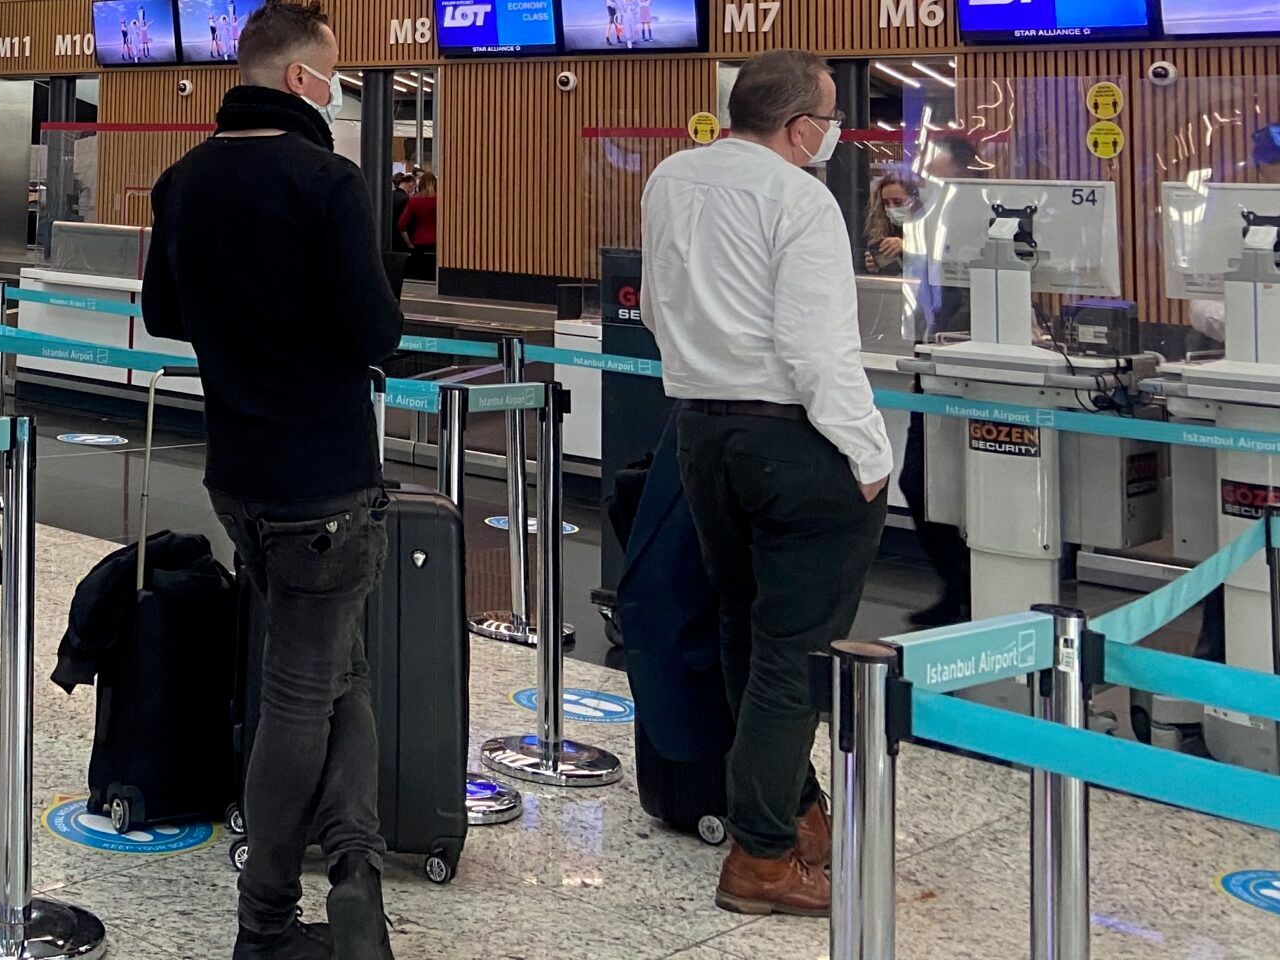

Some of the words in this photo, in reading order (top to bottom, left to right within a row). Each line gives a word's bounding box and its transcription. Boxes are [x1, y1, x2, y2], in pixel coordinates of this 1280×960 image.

[507, 1, 548, 11] ECONOMY
[443, 4, 492, 28] LOT
[522, 12, 549, 22] CLASS
[723, 1, 781, 34] M7
[389, 17, 432, 45] M8
[1014, 29, 1036, 37] STAR
[1037, 27, 1081, 36] ALLIANCE
[54, 33, 95, 57] M10
[1071, 188, 1098, 207] 54
[42, 347, 69, 359] Istanbul
[70, 349, 94, 362] Airport
[573, 355, 606, 369] Istanbul
[606, 359, 635, 372] Airport
[396, 394, 428, 409] Airport
[945, 404, 990, 419] Istanbul
[992, 408, 1031, 423] Airport
[969, 421, 1039, 445] GÖZEN
[1183, 431, 1234, 447] Istanbul
[1238, 437, 1280, 453] Airport
[971, 439, 1038, 455] SECURITY
[926, 656, 976, 685] Istanbul
[978, 646, 1019, 674] Airport
